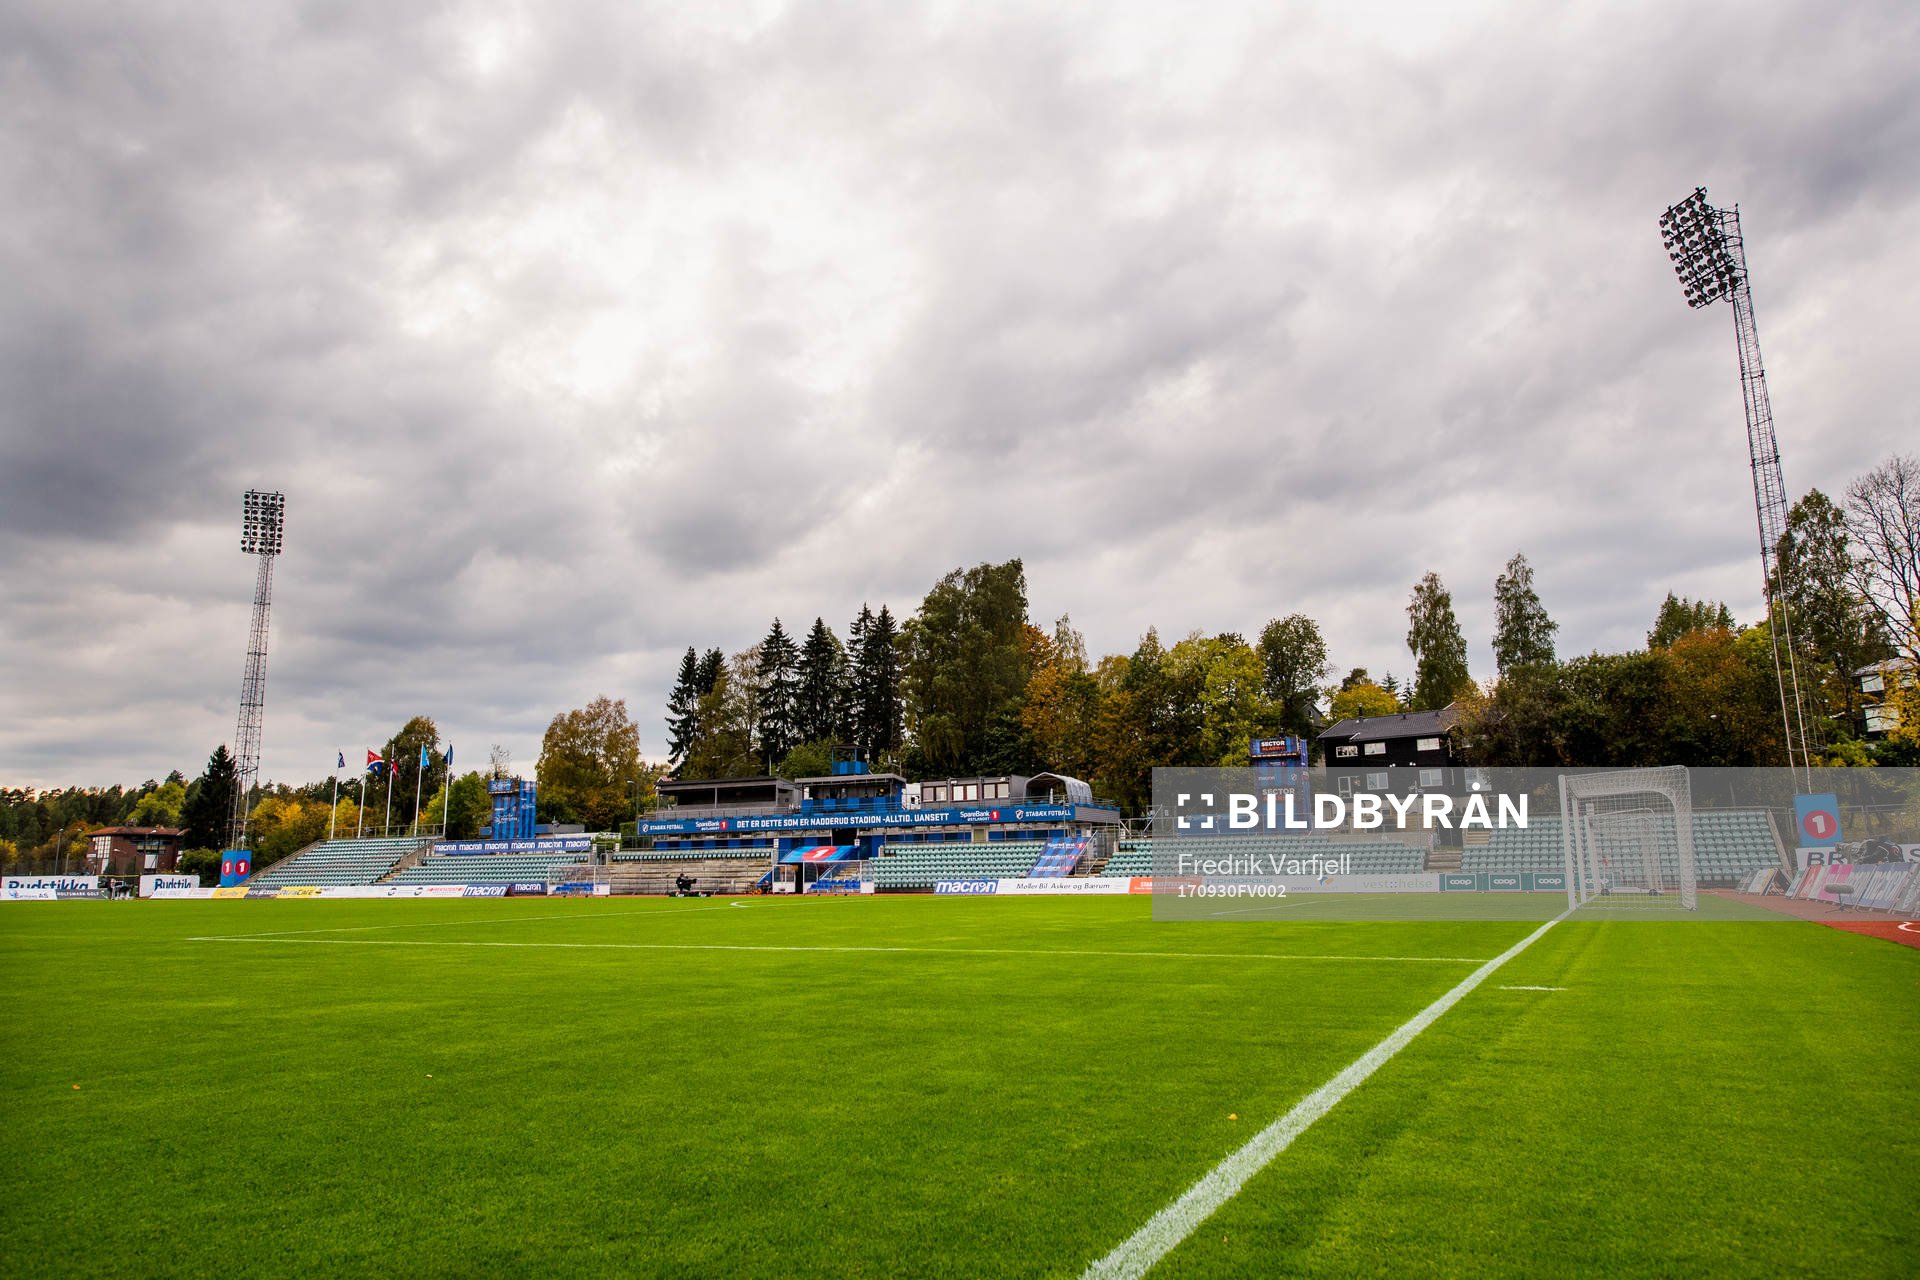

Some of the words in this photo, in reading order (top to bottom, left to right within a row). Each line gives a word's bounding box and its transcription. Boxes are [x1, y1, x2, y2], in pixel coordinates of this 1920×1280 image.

[736, 820, 750, 828] DET
[750, 819, 760, 828] ER
[761, 819, 782, 828] DETTE
[783, 819, 799, 827] SOM
[800, 818, 809, 826] ER
[850, 815, 881, 825] STADION
[914, 813, 950, 822] UANSETT
[1812, 815, 1826, 834] 1
[484, 842, 509, 850] macron
[538, 841, 563, 849] macron
[565, 840, 591, 848] macron
[515, 883, 541, 891] macron
[936, 881, 997, 893] macron
[1493, 878, 1517, 886] coop
[464, 886, 506, 896] macron
